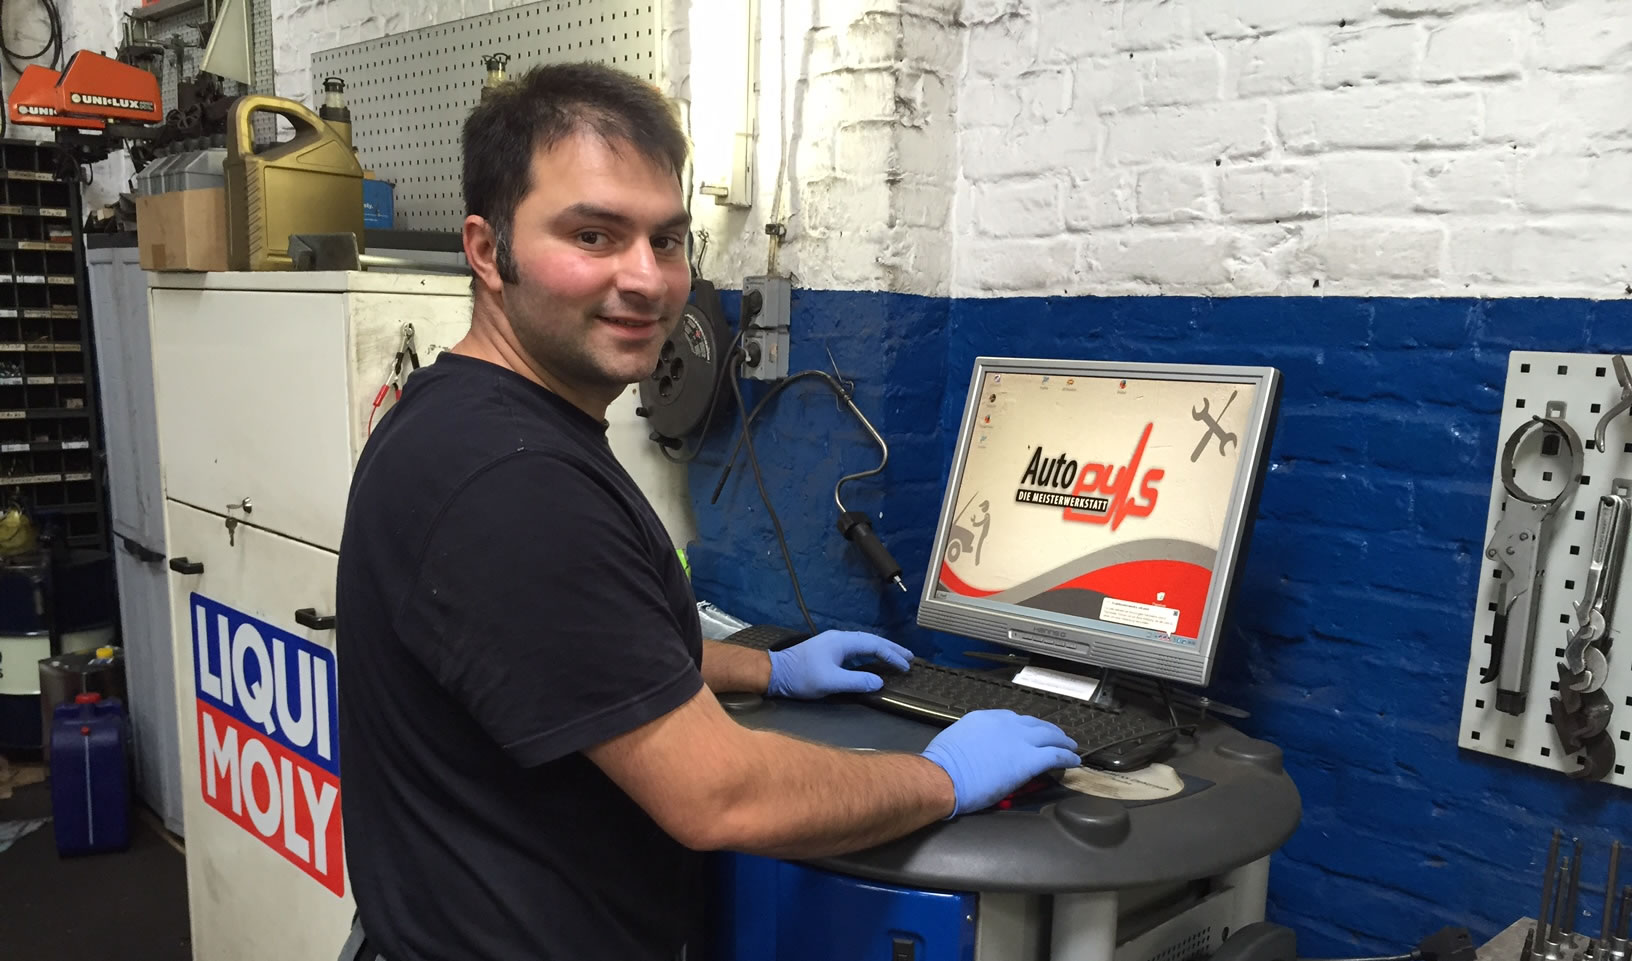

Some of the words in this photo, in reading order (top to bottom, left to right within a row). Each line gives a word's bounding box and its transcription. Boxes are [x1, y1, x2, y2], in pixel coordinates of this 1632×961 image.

[1018, 491, 1031, 501] DIE
[1032, 492, 1108, 511] MEISTERWERKSTATT
[196, 604, 331, 761] LIQUI
[202, 711, 338, 876] MOLY
